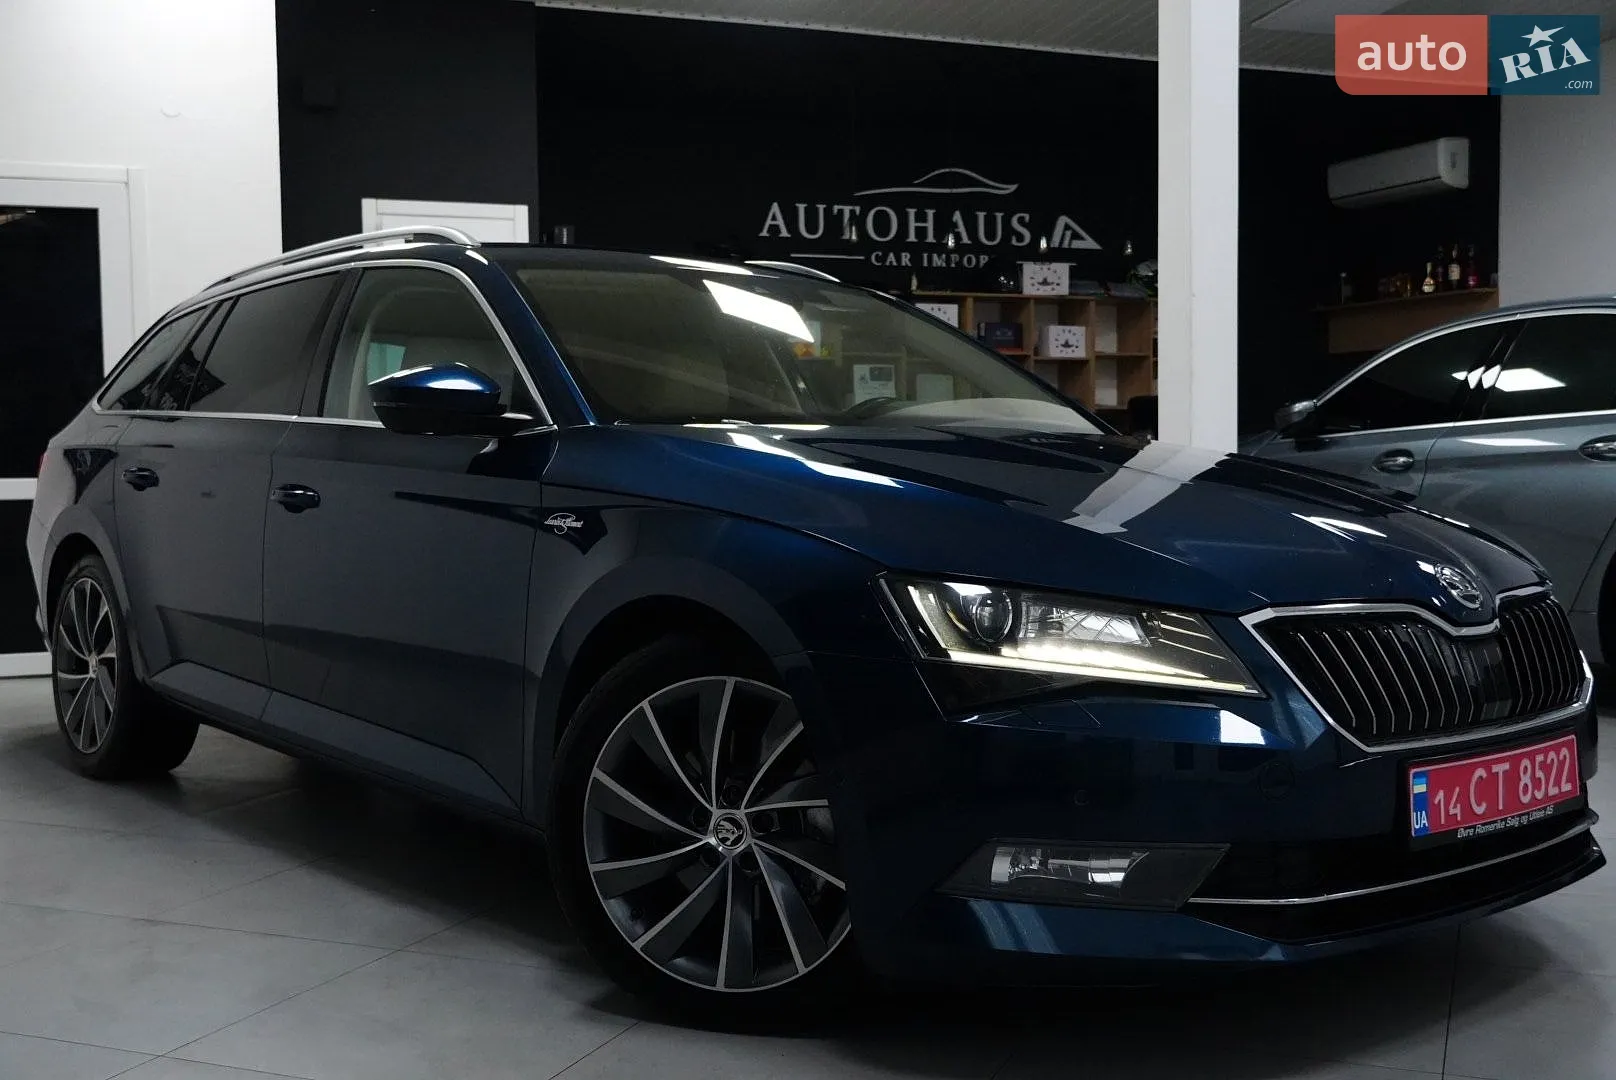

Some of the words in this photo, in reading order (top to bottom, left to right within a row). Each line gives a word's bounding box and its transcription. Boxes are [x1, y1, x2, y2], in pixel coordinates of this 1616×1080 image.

[758, 201, 1031, 247] AUTOHAUS
[870, 251, 912, 267] CAR
[1518, 747, 1572, 804] 8522
[1413, 811, 1429, 829] UA
